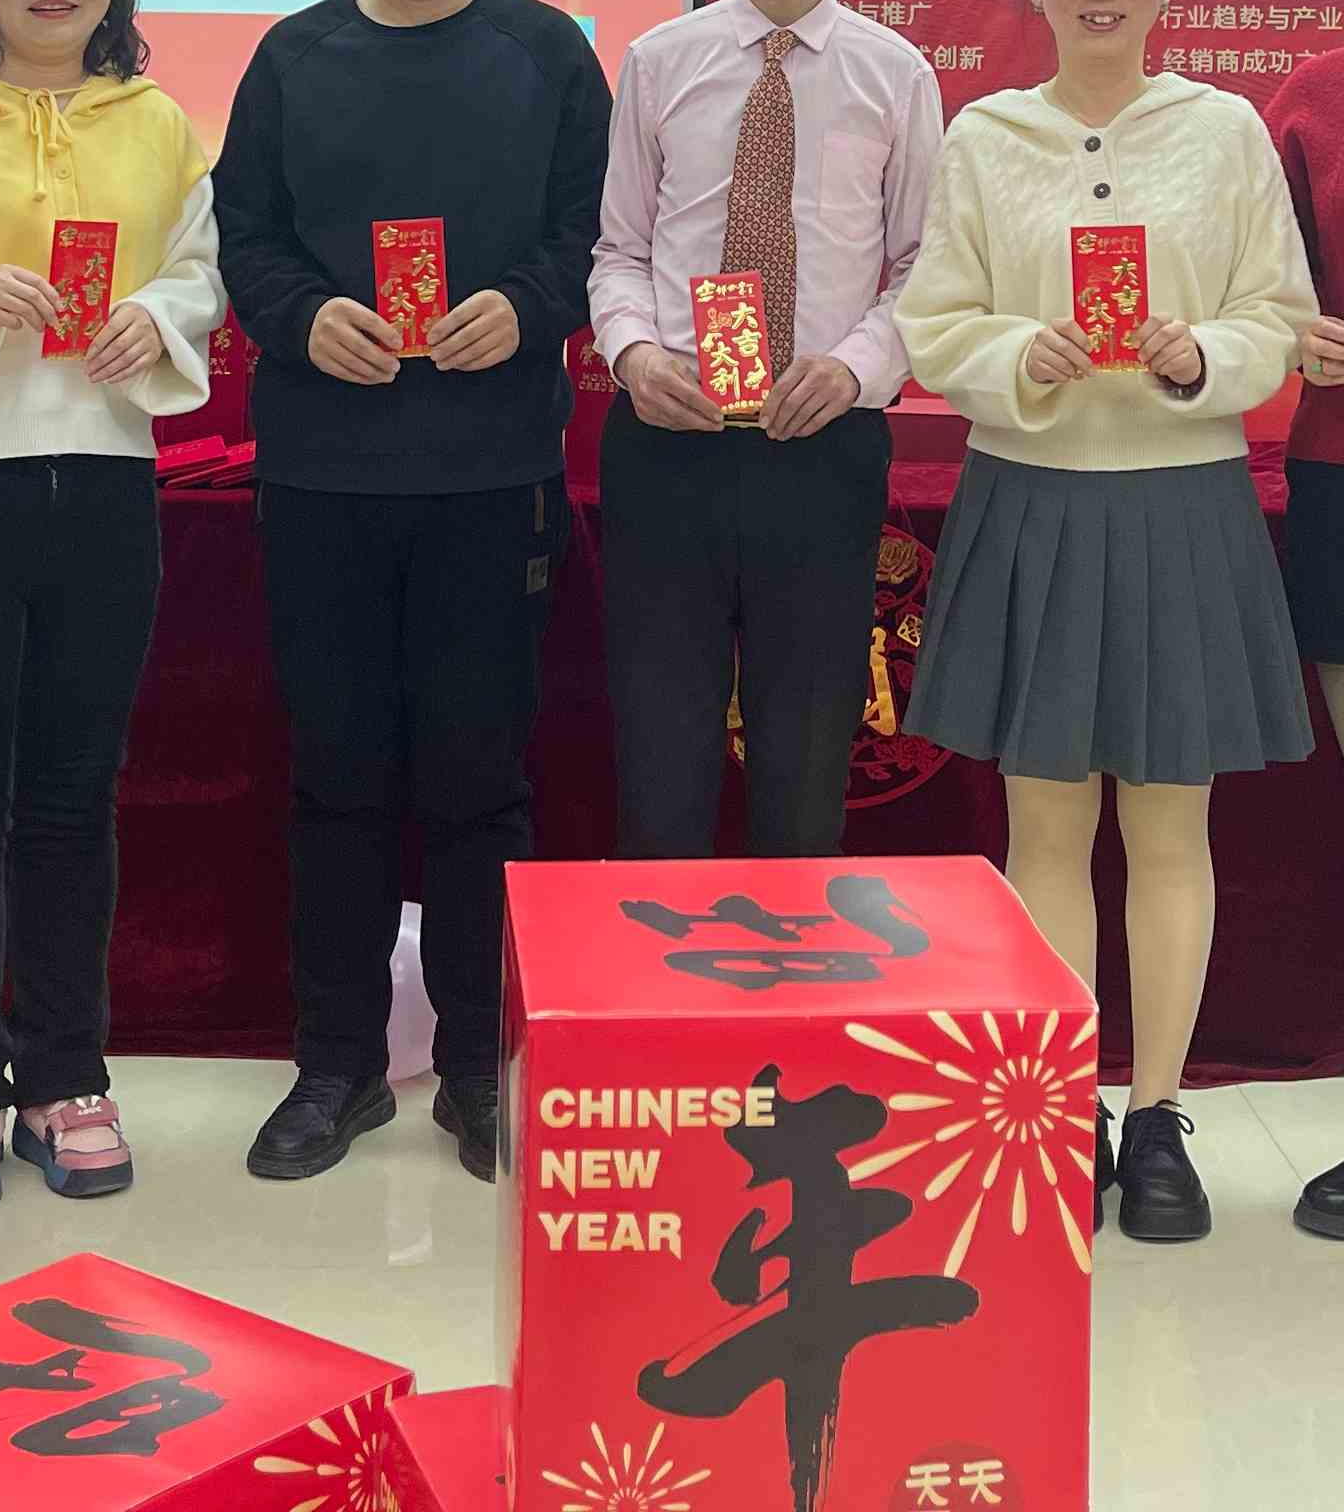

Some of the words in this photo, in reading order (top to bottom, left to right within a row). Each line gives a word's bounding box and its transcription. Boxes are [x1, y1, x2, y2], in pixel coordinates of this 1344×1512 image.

[919, 44, 985, 71] 创新
[539, 1087, 776, 1137] CHINESE
[539, 1148, 662, 1199] NEW
[538, 1211, 682, 1261] YEAR
[905, 1459, 1005, 1506] 天天
